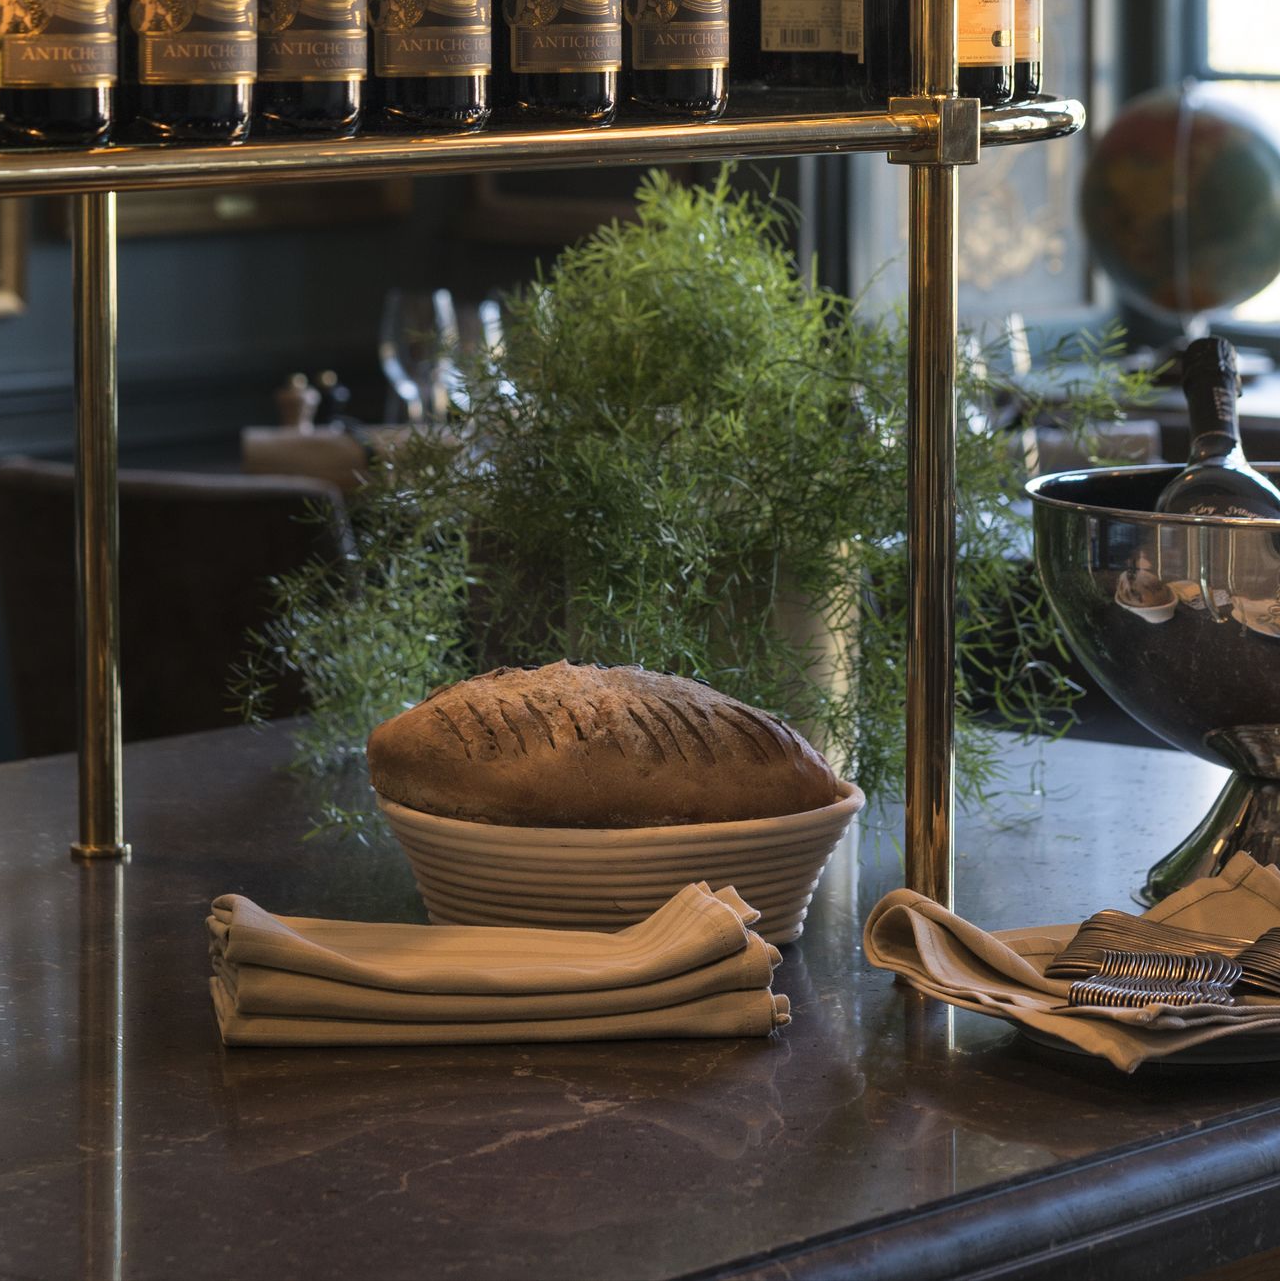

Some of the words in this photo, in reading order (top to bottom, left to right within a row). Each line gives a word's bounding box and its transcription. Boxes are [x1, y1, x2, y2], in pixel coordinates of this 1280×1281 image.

[397, 38, 469, 52] ANTICHE
[532, 35, 603, 48] ANTICHE
[654, 32, 718, 45] ANTICHE
[163, 44, 239, 57] ANTICHE
[267, 41, 344, 55] ANTICHE
